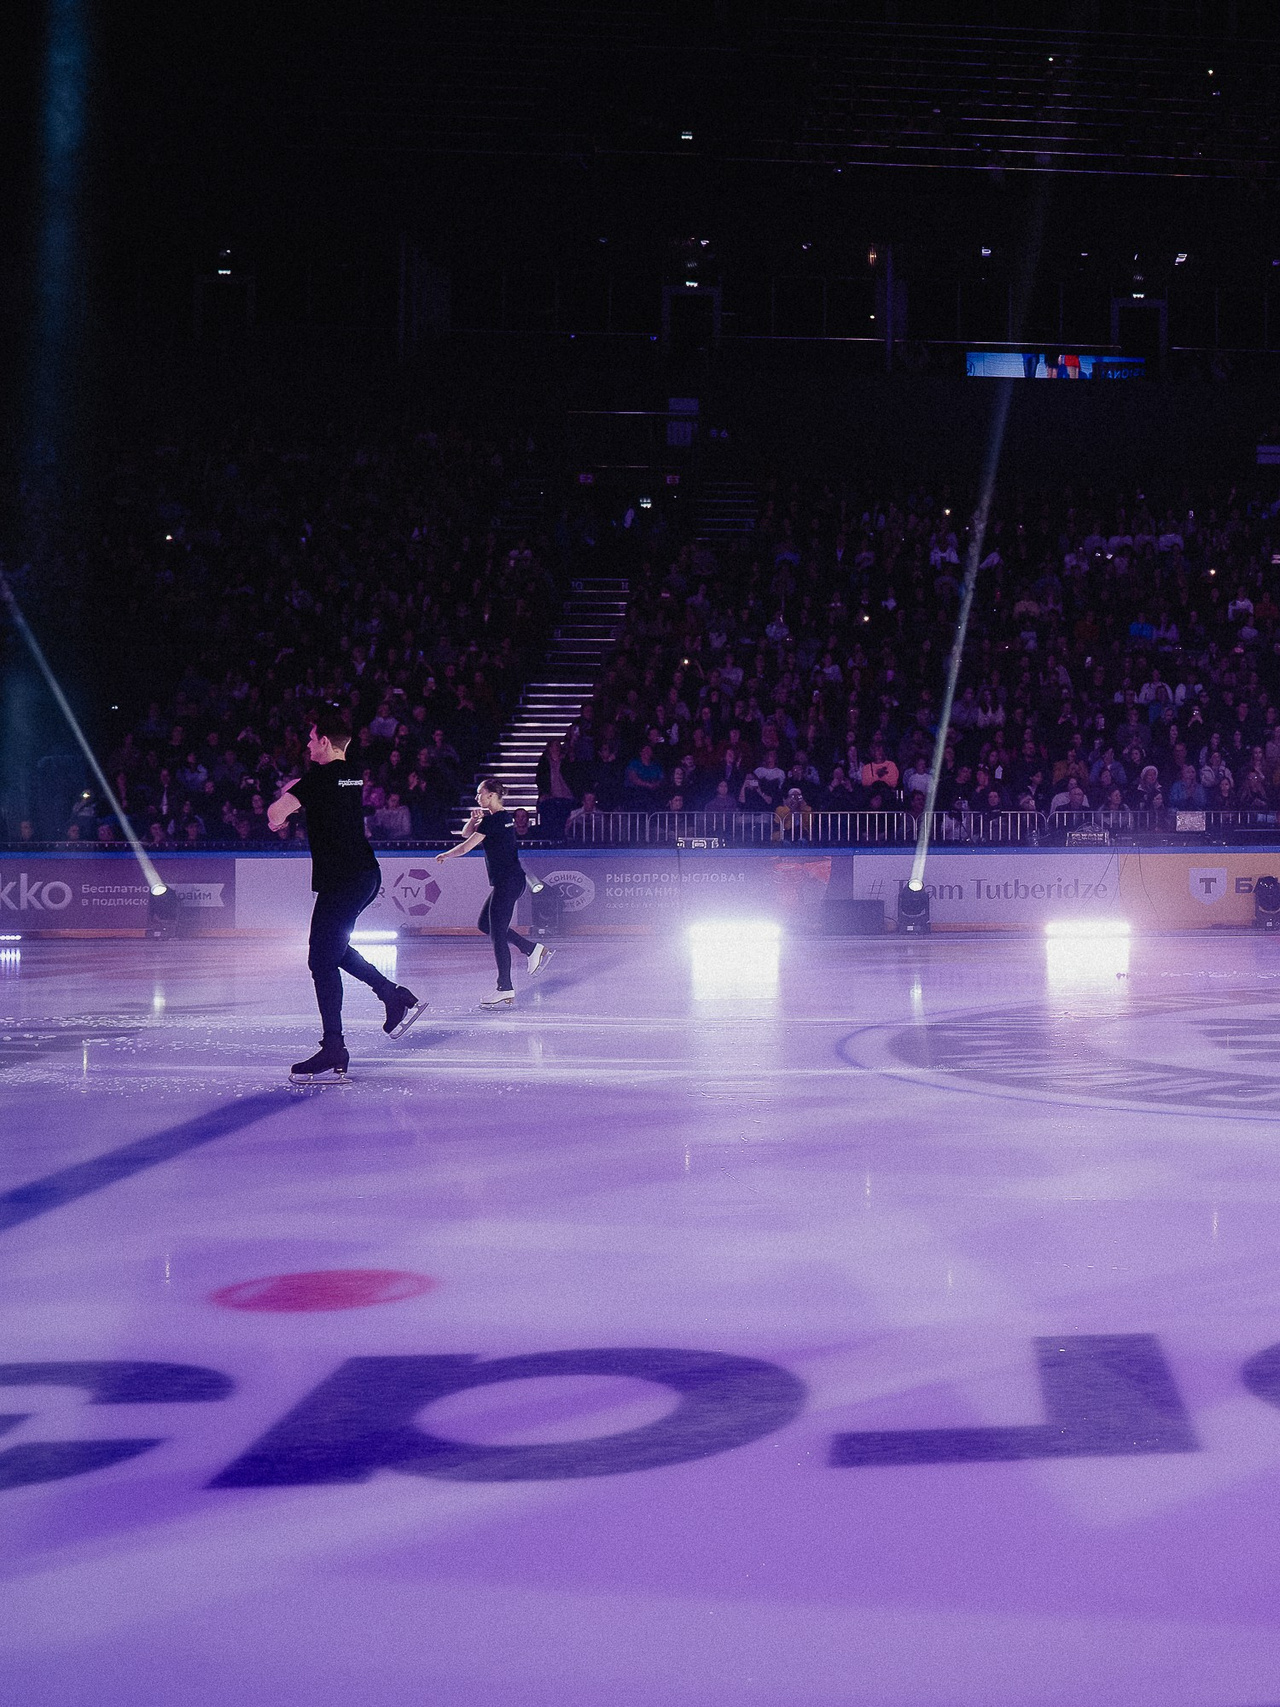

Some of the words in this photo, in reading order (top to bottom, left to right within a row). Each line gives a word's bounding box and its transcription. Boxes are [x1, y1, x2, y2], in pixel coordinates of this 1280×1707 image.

[606, 873, 746, 883] РЫБОПРОМЫСЛОВАЯ
[81, 884, 150, 894] Бесплатно
[401, 887, 421, 898] TV
[606, 887, 681, 897] КОМПАНИЯ
[970, 877, 1109, 900] Tutberidze
[92, 898, 149, 907] подписк
